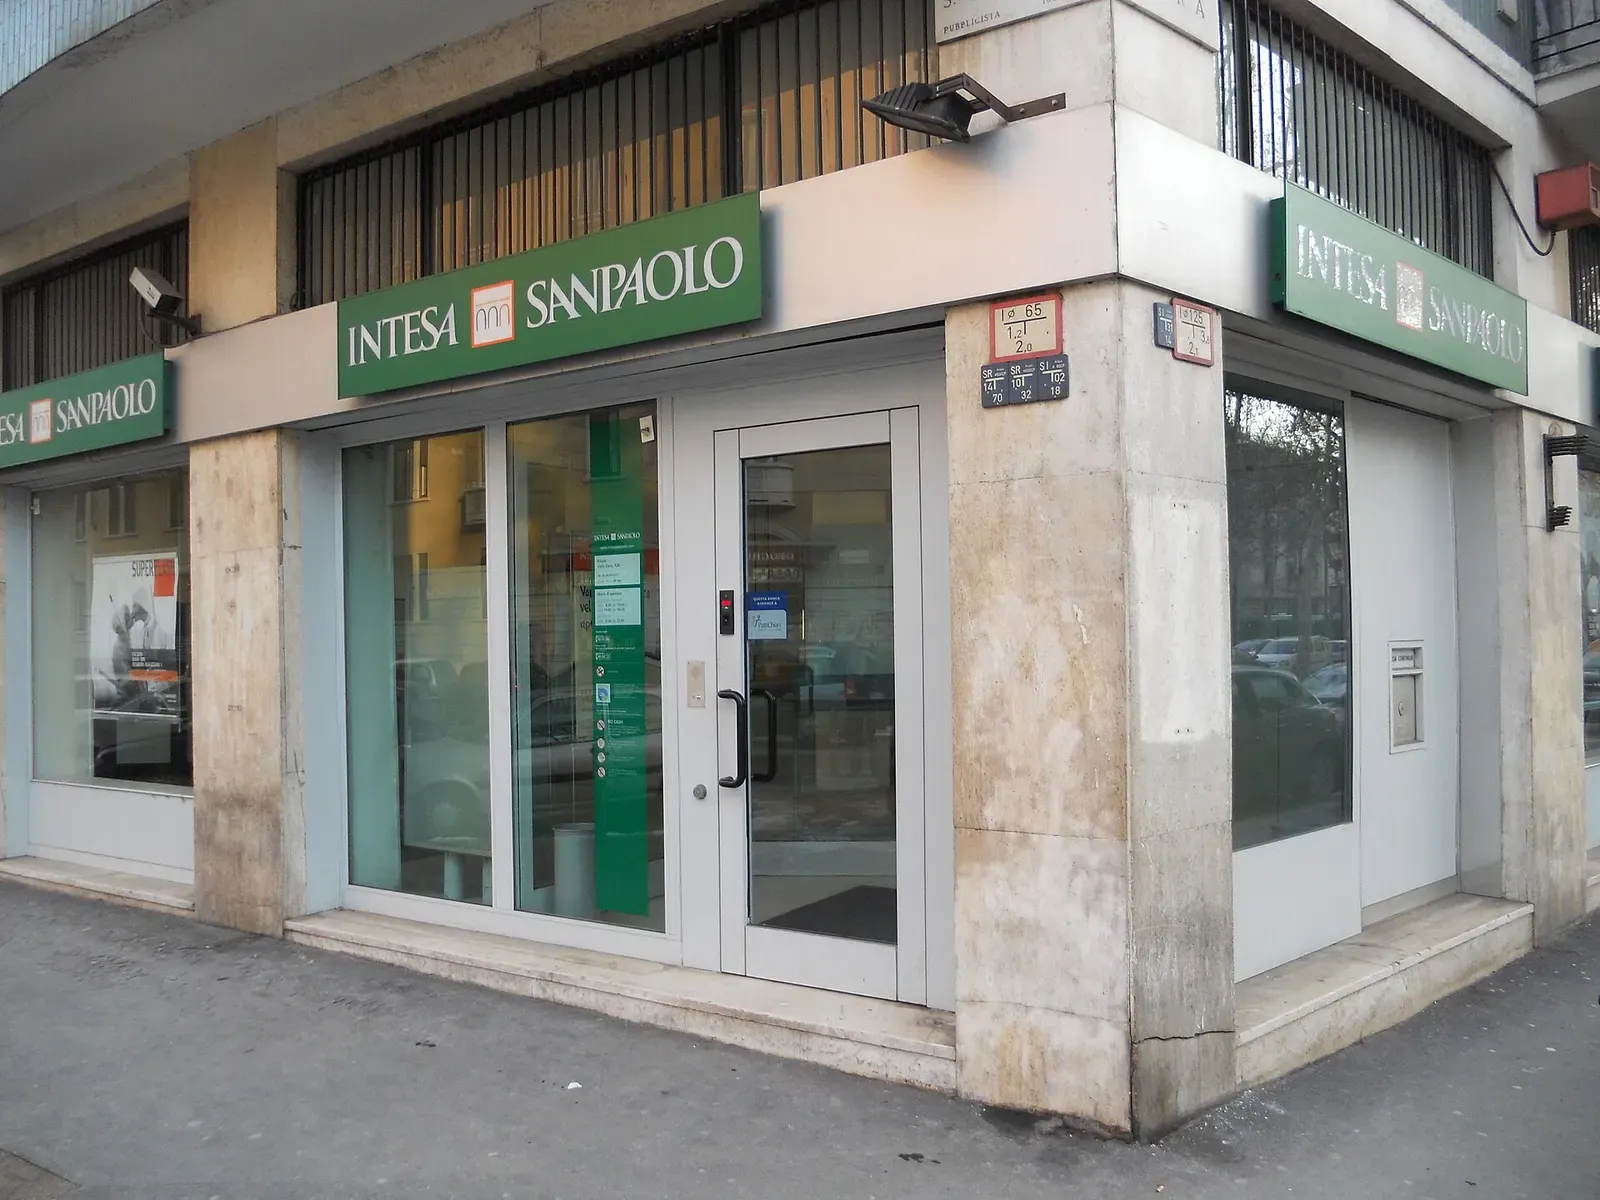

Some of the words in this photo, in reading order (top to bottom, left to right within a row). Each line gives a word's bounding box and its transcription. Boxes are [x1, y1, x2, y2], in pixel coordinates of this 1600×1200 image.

[1297, 223, 1388, 311] INTESA
[1428, 285, 1523, 364] SANPAOLO
[347, 302, 459, 367] INTESA
[526, 235, 744, 329] SANPAOLO
[1025, 303, 1042, 317] 65
[1010, 365, 1021, 376] SR
[1039, 361, 1049, 371] SI
[982, 369, 993, 379] SR
[56, 378, 157, 433] SANPAOLO
